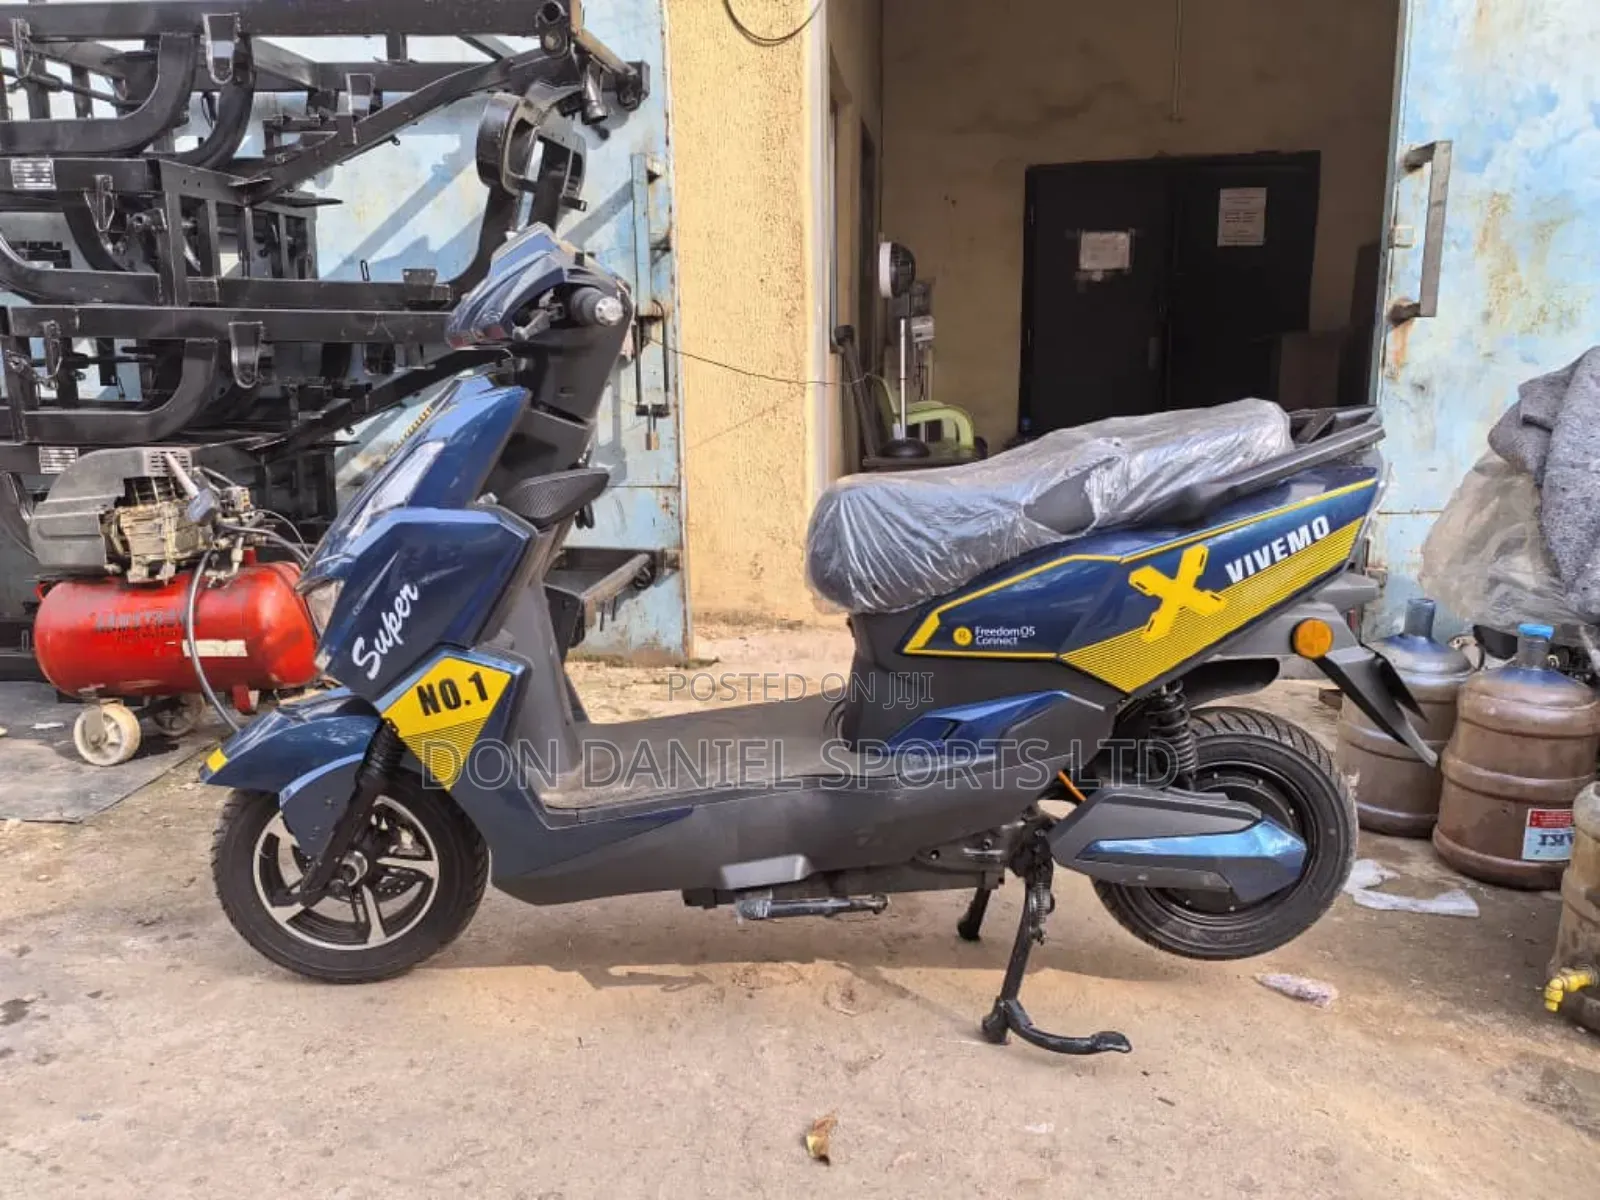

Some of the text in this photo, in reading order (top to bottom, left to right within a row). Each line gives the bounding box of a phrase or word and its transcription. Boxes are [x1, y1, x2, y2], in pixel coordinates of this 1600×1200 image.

[1225, 515, 1331, 584] VIVEMO
[351, 582, 419, 681] Super
[975, 636, 1018, 646] Connect
